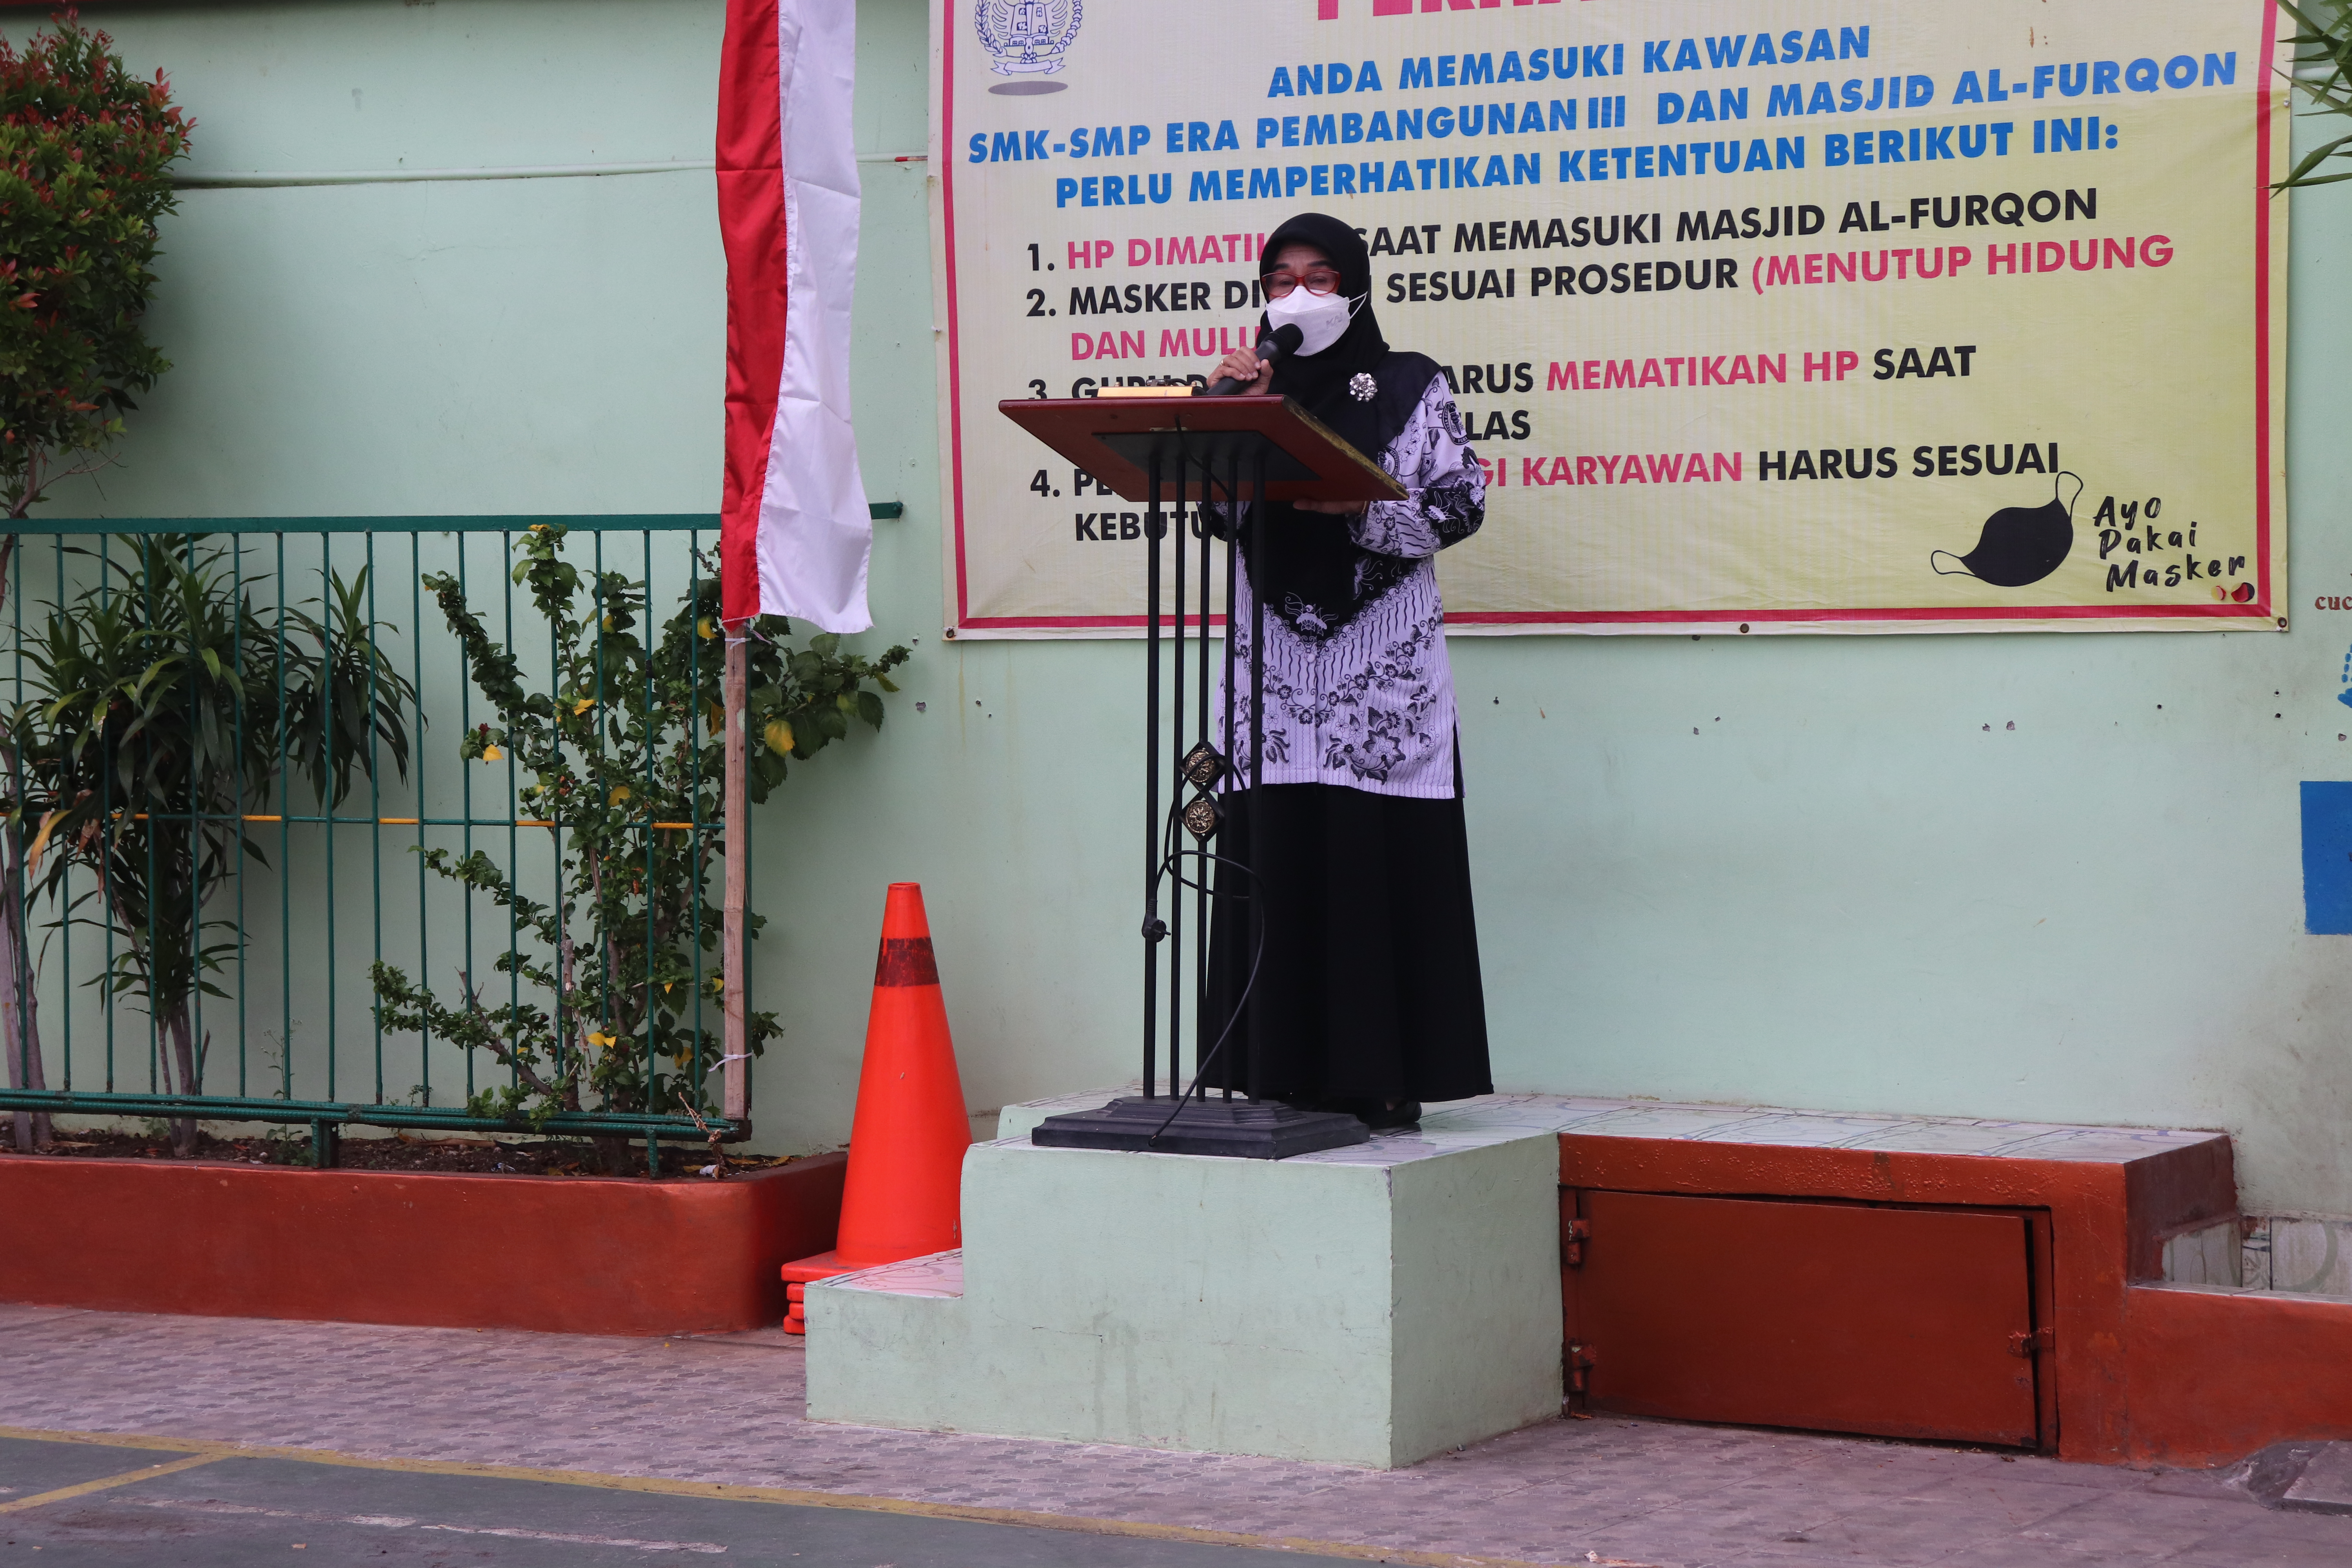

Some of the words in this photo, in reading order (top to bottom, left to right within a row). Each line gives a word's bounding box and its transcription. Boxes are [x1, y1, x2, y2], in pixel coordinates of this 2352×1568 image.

[1268, 61, 1382, 98] ANDA
[1399, 44, 1624, 89] MEMASUKI
[1644, 26, 1869, 73] KAWASAN
[969, 125, 1151, 163] SMK-SMP
[1167, 120, 1240, 153] ERA
[1257, 99, 1576, 148] PEMBANGUNAN
[1588, 96, 1625, 129] III
[1658, 87, 1748, 124] DAN
[1767, 75, 1934, 117] MASJID
[1953, 52, 2236, 104] AL-FURQON
[1057, 173, 1171, 208] PERLU
[1189, 153, 1540, 201] MEMPERHATIKAN
[1560, 136, 1804, 182] KETENTUAN
[1826, 122, 2013, 166] BERIKUT
[2034, 117, 2117, 153] INI:
[1028, 244, 1054, 270] 1.
[1068, 240, 1114, 269] HP
[1454, 214, 1660, 253] MEMASUKI
[1677, 204, 1825, 242] MASJID
[1839, 188, 2096, 233] AL-FURQON
[1026, 289, 1056, 316] 2.
[1069, 282, 1210, 315] MASKER
[1387, 269, 1515, 303] SESUAI
[1532, 258, 1738, 296] PROSEDUR
[1753, 246, 1972, 295] (MENUTUP
[1988, 235, 2174, 275] HIDUNG
[1071, 330, 1145, 360] DAN
[1159, 326, 1261, 358] MULU
[1442, 362, 1533, 394] ARUS
[1547, 353, 1786, 391] MEMATIKAN
[1804, 351, 1859, 382] HP
[1873, 345, 1976, 380] SAAT
[1030, 470, 1060, 497] 4.
[1523, 452, 1742, 486] KARYAWAN
[1759, 447, 1898, 481] HARUS
[1913, 443, 2058, 477] SESUAI
[2093, 496, 2161, 530] Ayo
[2099, 521, 2197, 560] Pakai
[2106, 554, 2245, 592] Masker
